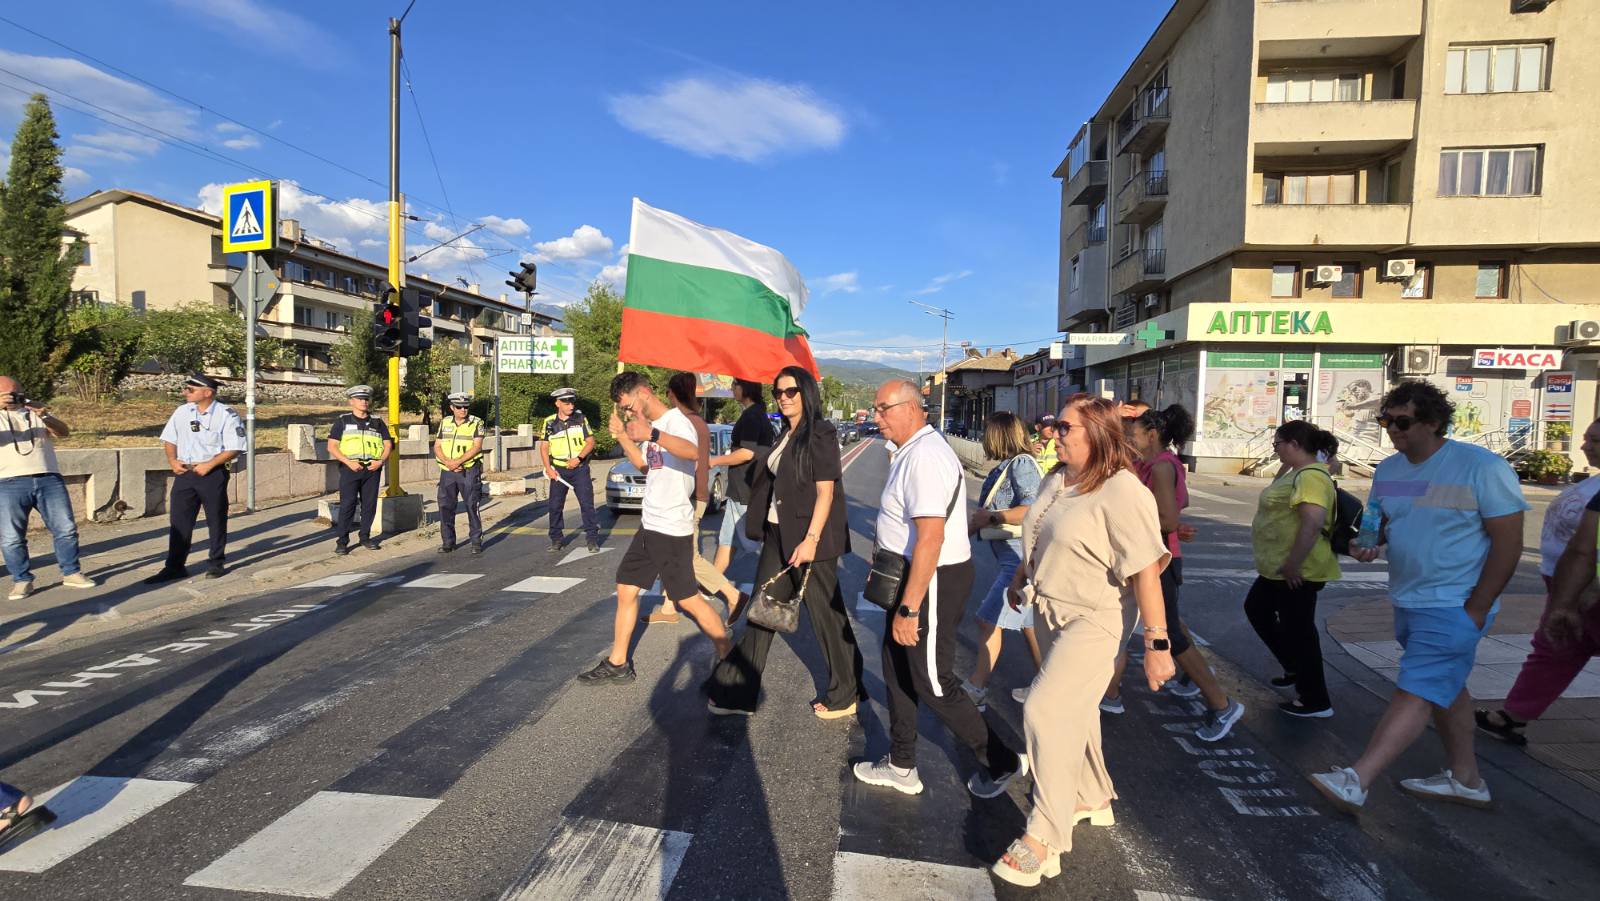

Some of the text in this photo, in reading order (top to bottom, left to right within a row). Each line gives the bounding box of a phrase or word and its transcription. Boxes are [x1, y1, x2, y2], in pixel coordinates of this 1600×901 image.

[1206, 310, 1333, 334] АПТЕКА
[1070, 335, 1129, 344] PHARMACY
[500, 340, 549, 352] АПТЕКА
[500, 358, 568, 370] PHARMACY
[1497, 353, 1556, 367] КАСА
[1547, 384, 1566, 392] Pay
